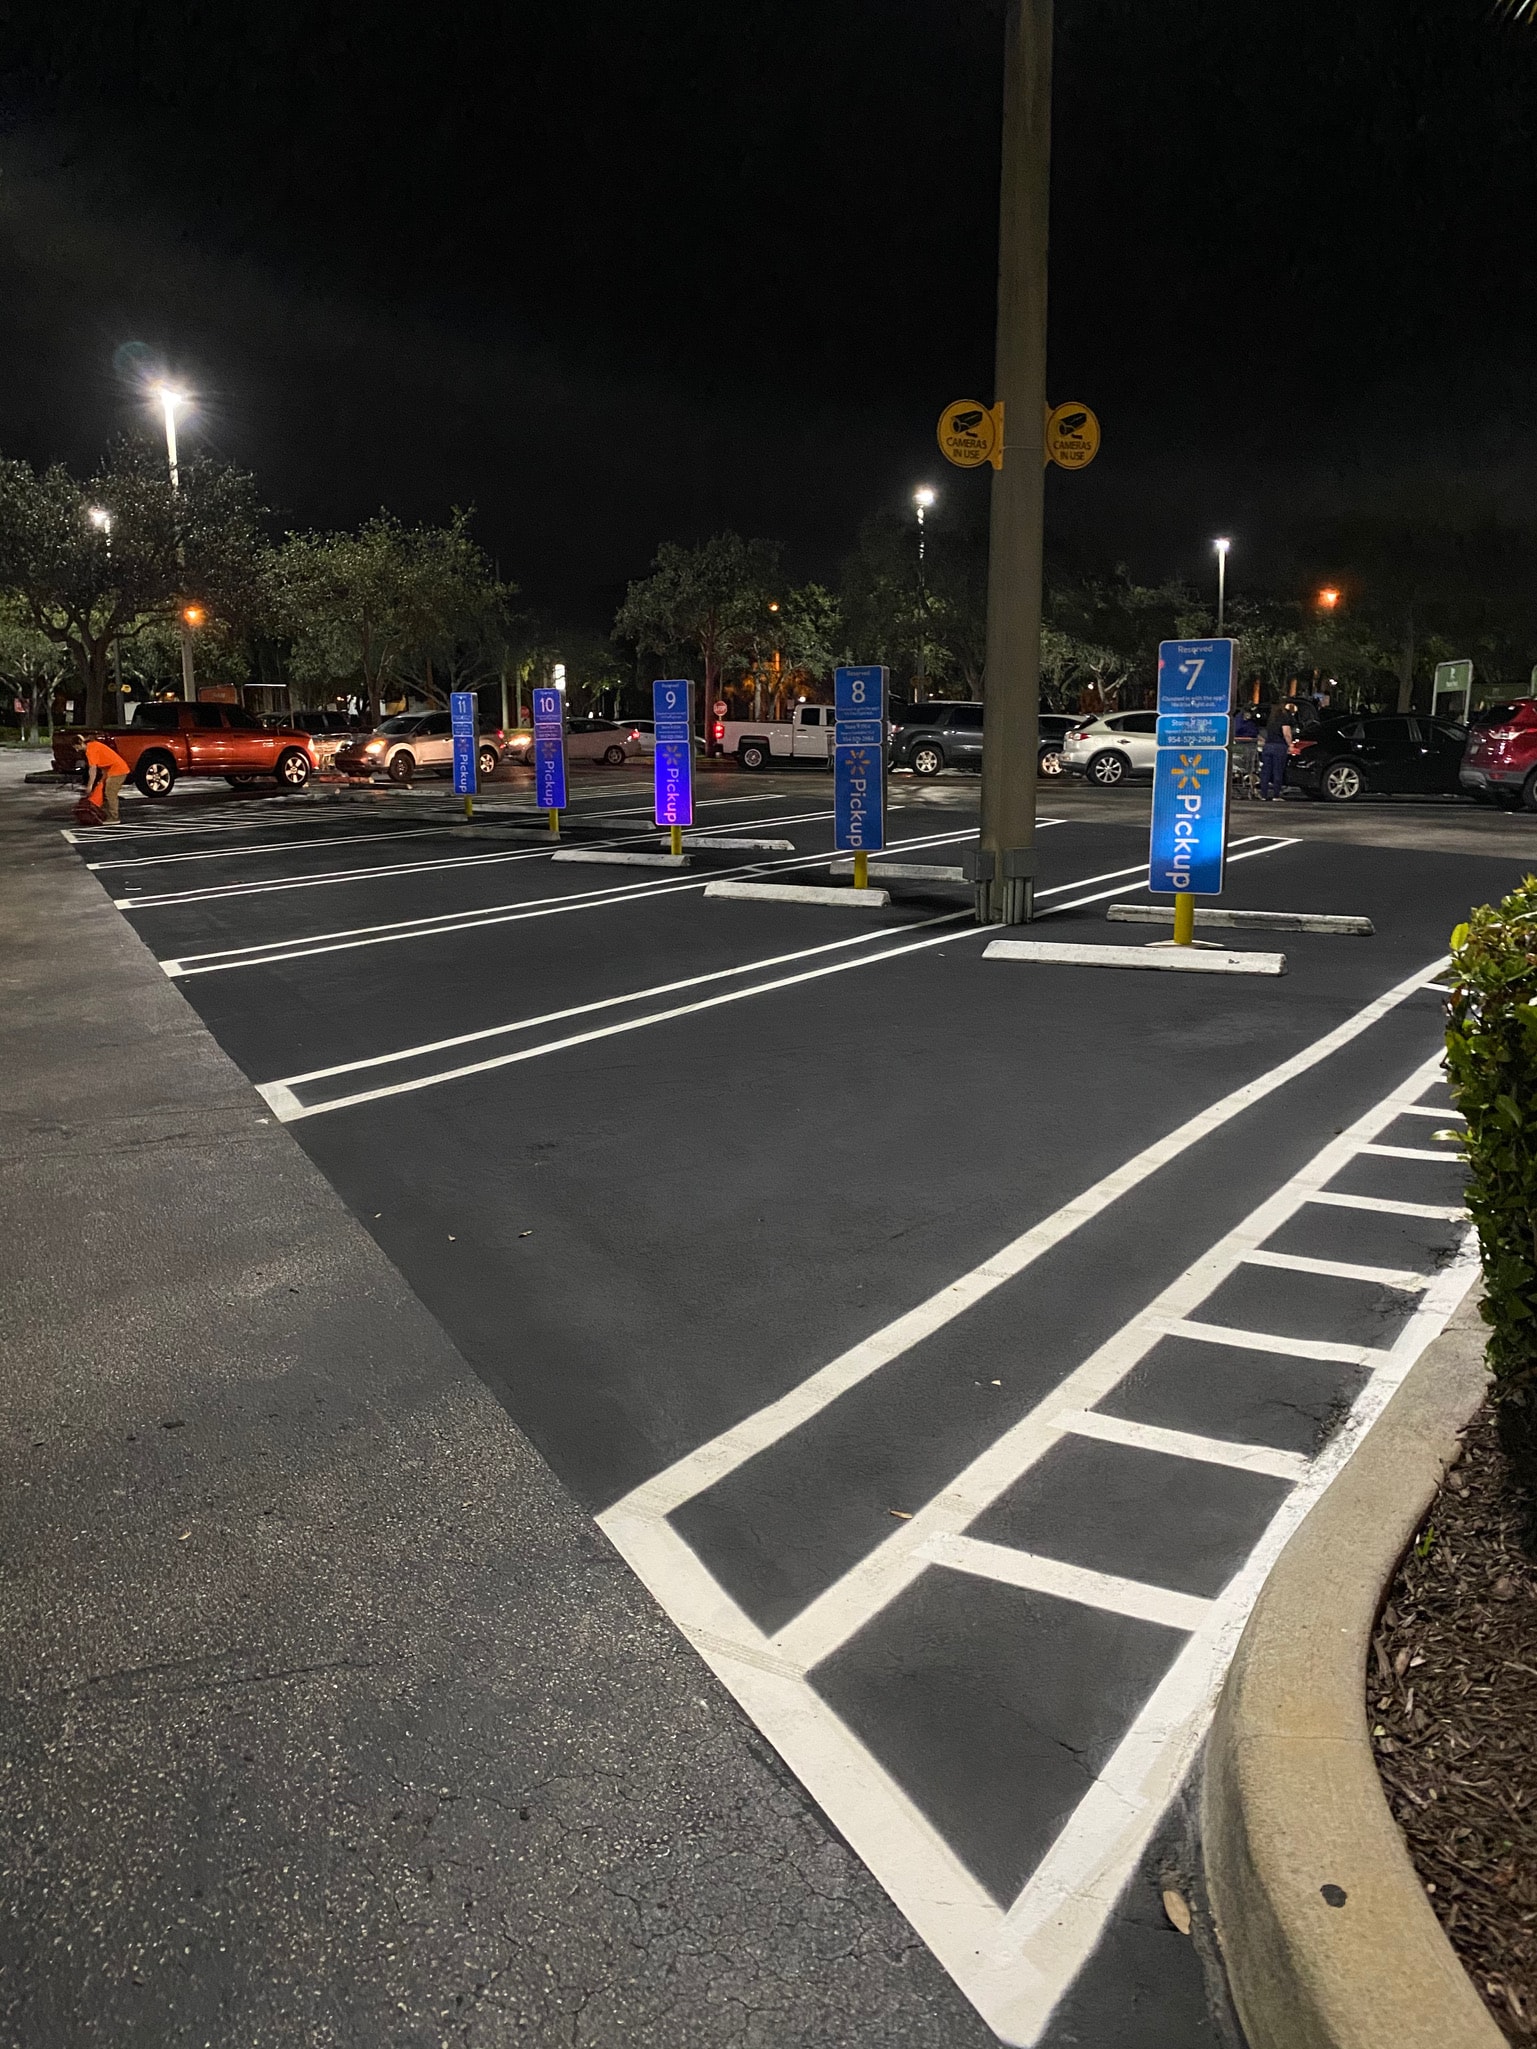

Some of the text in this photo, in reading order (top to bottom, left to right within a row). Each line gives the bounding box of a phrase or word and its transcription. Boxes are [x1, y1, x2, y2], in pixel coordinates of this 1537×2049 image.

[946, 437, 988, 450] CAMERAS
[1053, 440, 1092, 450] CAMERAS
[953, 450, 981, 460] IN USE
[1060, 451, 1085, 460] IN USE
[1178, 645, 1213, 653] Reserved
[1185, 659, 1205, 690] 7
[665, 691, 676, 709] 9
[852, 680, 865, 703] 8
[458, 700, 466, 713] 11
[540, 697, 555, 713] 10
[459, 754, 469, 793] Pickup
[543, 760, 555, 806] Pickup
[664, 768, 680, 823] Pickup
[845, 779, 867, 847] Pickup
[1165, 795, 1201, 888] Pickup
